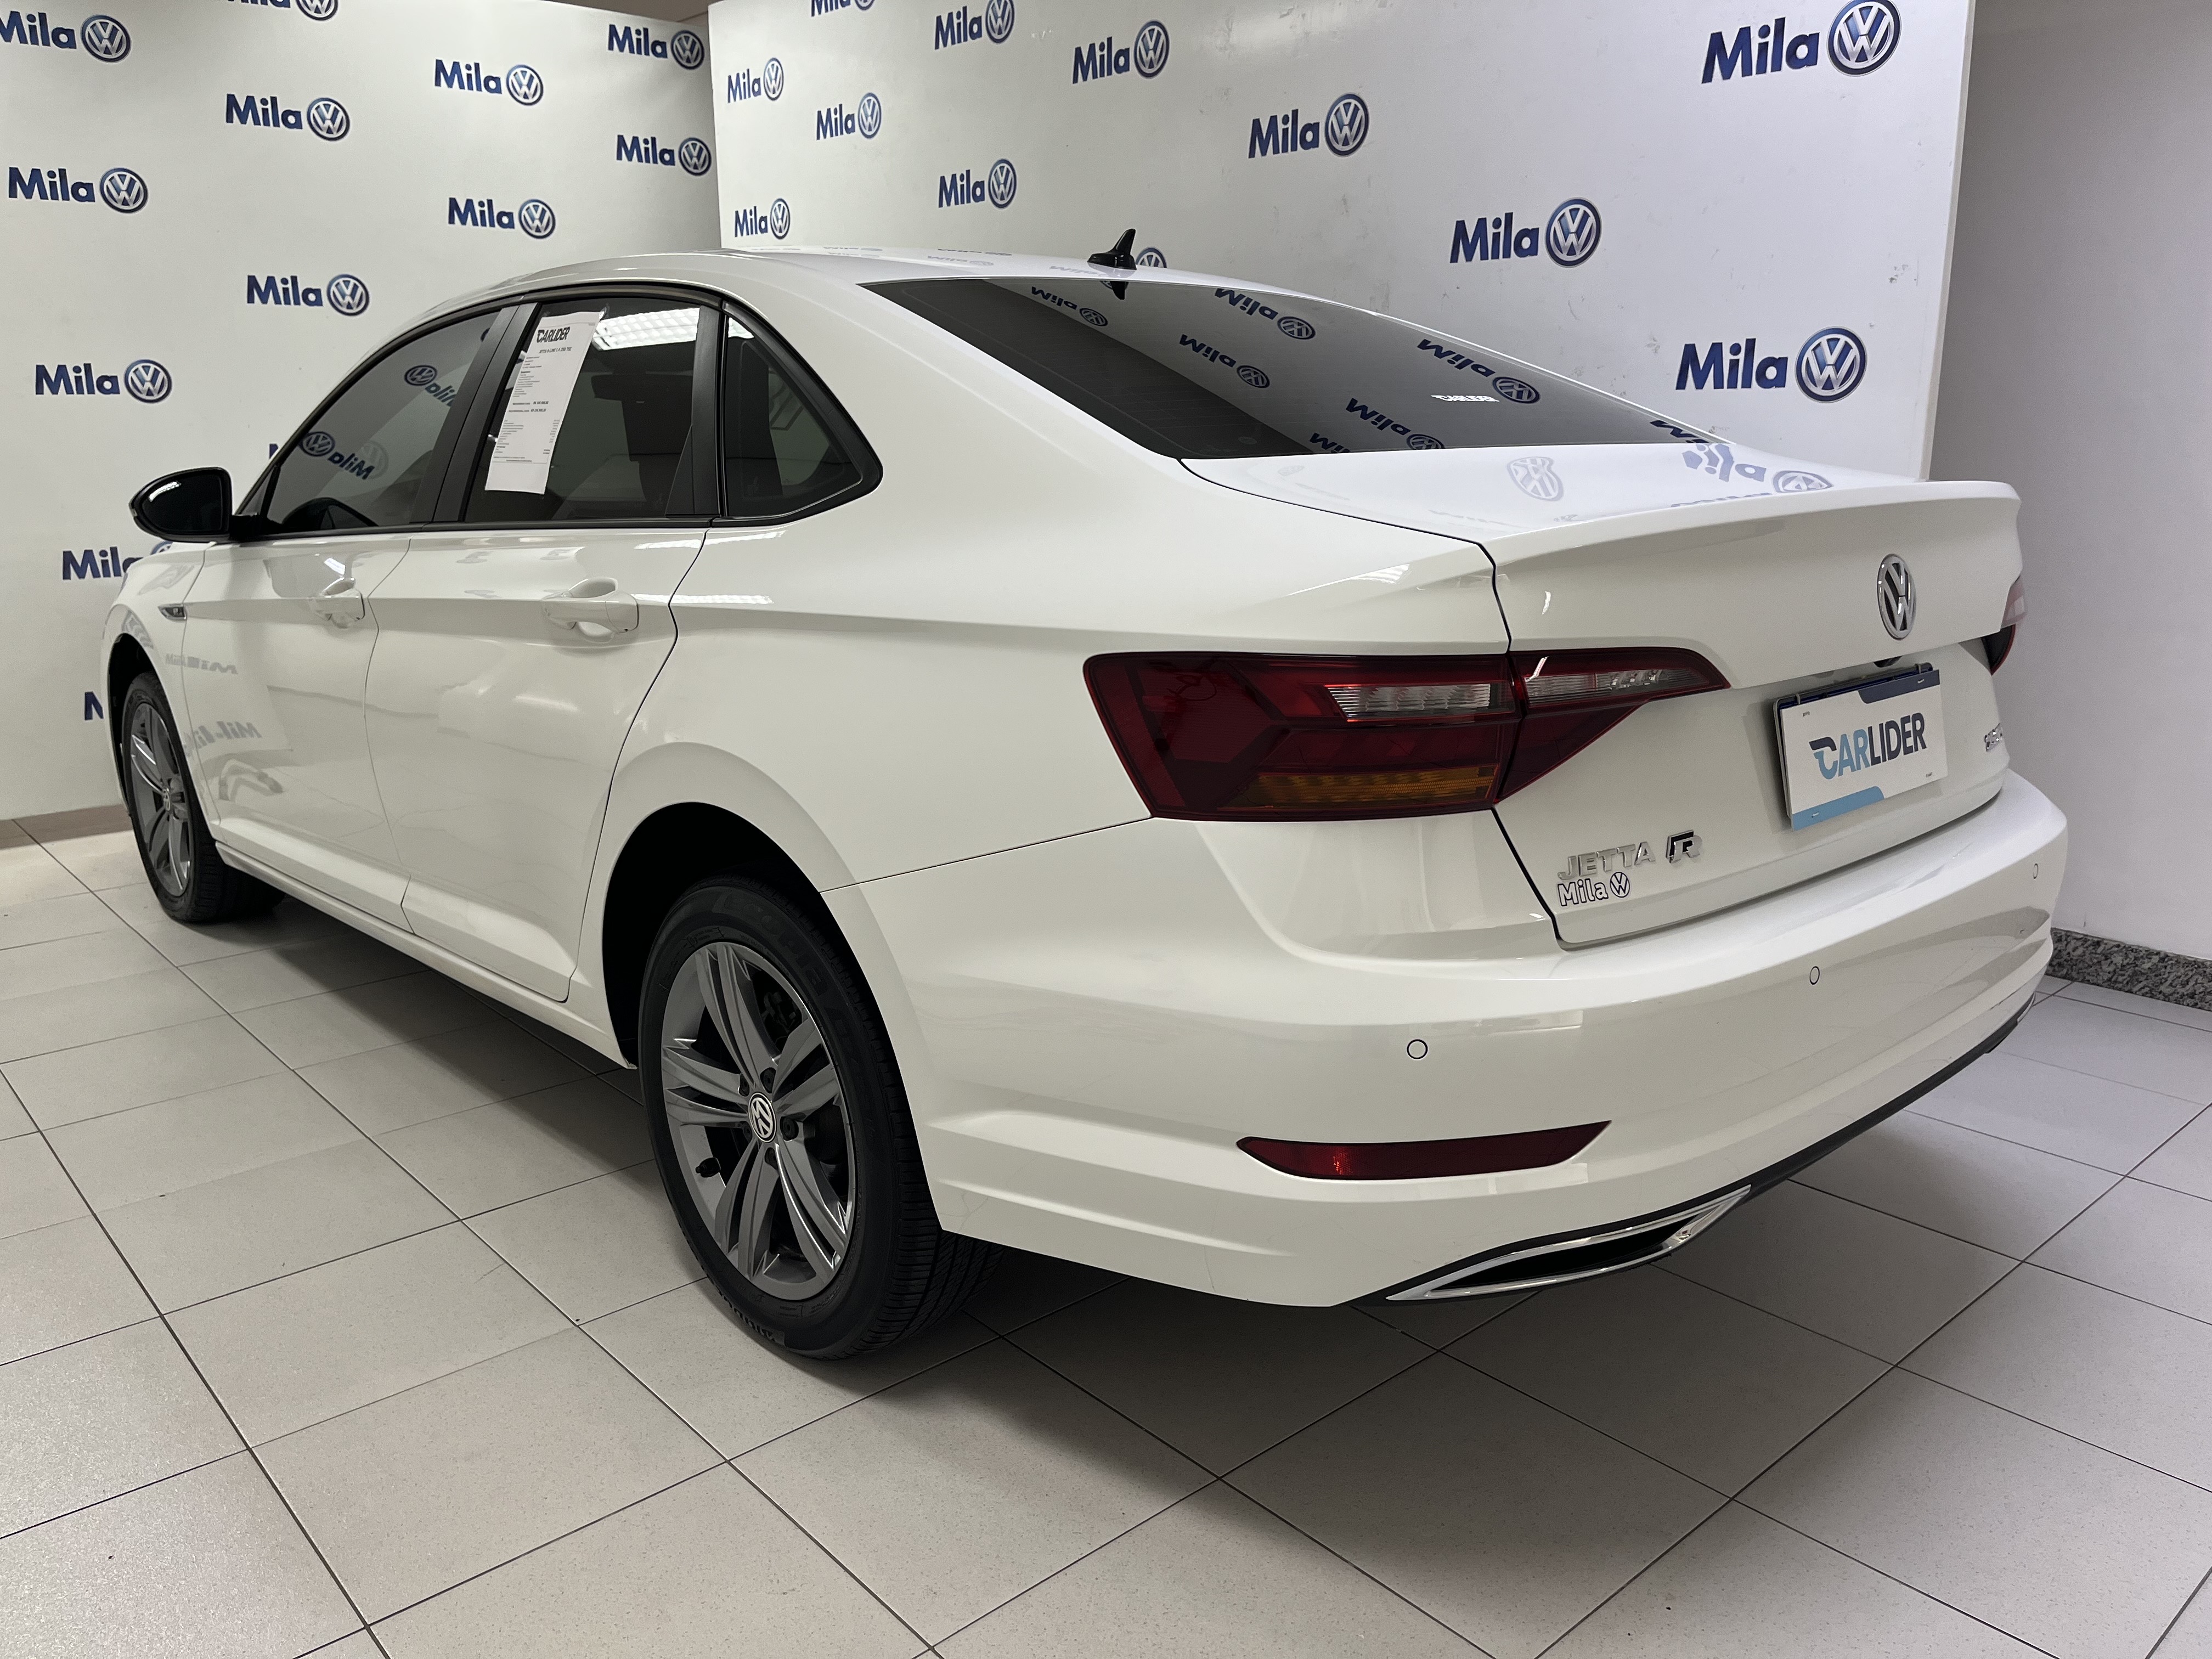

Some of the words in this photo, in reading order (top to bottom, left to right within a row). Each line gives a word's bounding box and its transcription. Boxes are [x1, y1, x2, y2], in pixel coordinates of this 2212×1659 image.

[0, 11, 77, 49] Mila
[608, 24, 669, 59] Mila
[935, 6, 982, 50] Mila
[1073, 36, 1130, 84] Mila
[1702, 17, 1820, 84] Mila
[435, 59, 502, 94] Mila
[728, 69, 761, 103] Mila
[226, 94, 302, 129] Mila
[817, 104, 855, 140] Mila
[617, 135, 675, 166] Mila
[1249, 109, 1320, 159] Mila
[9, 167, 95, 202] Mila
[939, 170, 985, 208] Mila
[448, 198, 515, 229] Mila
[735, 206, 768, 237] Mila
[1450, 212, 1539, 263] Mila
[247, 275, 323, 306] Mila
[36, 363, 120, 395] Mila
[1675, 338, 1788, 390] Mila
[1809, 713, 1927, 780] CARLIDER
[1558, 841, 1656, 880] JETTA
[1558, 878, 1609, 906] Mila
